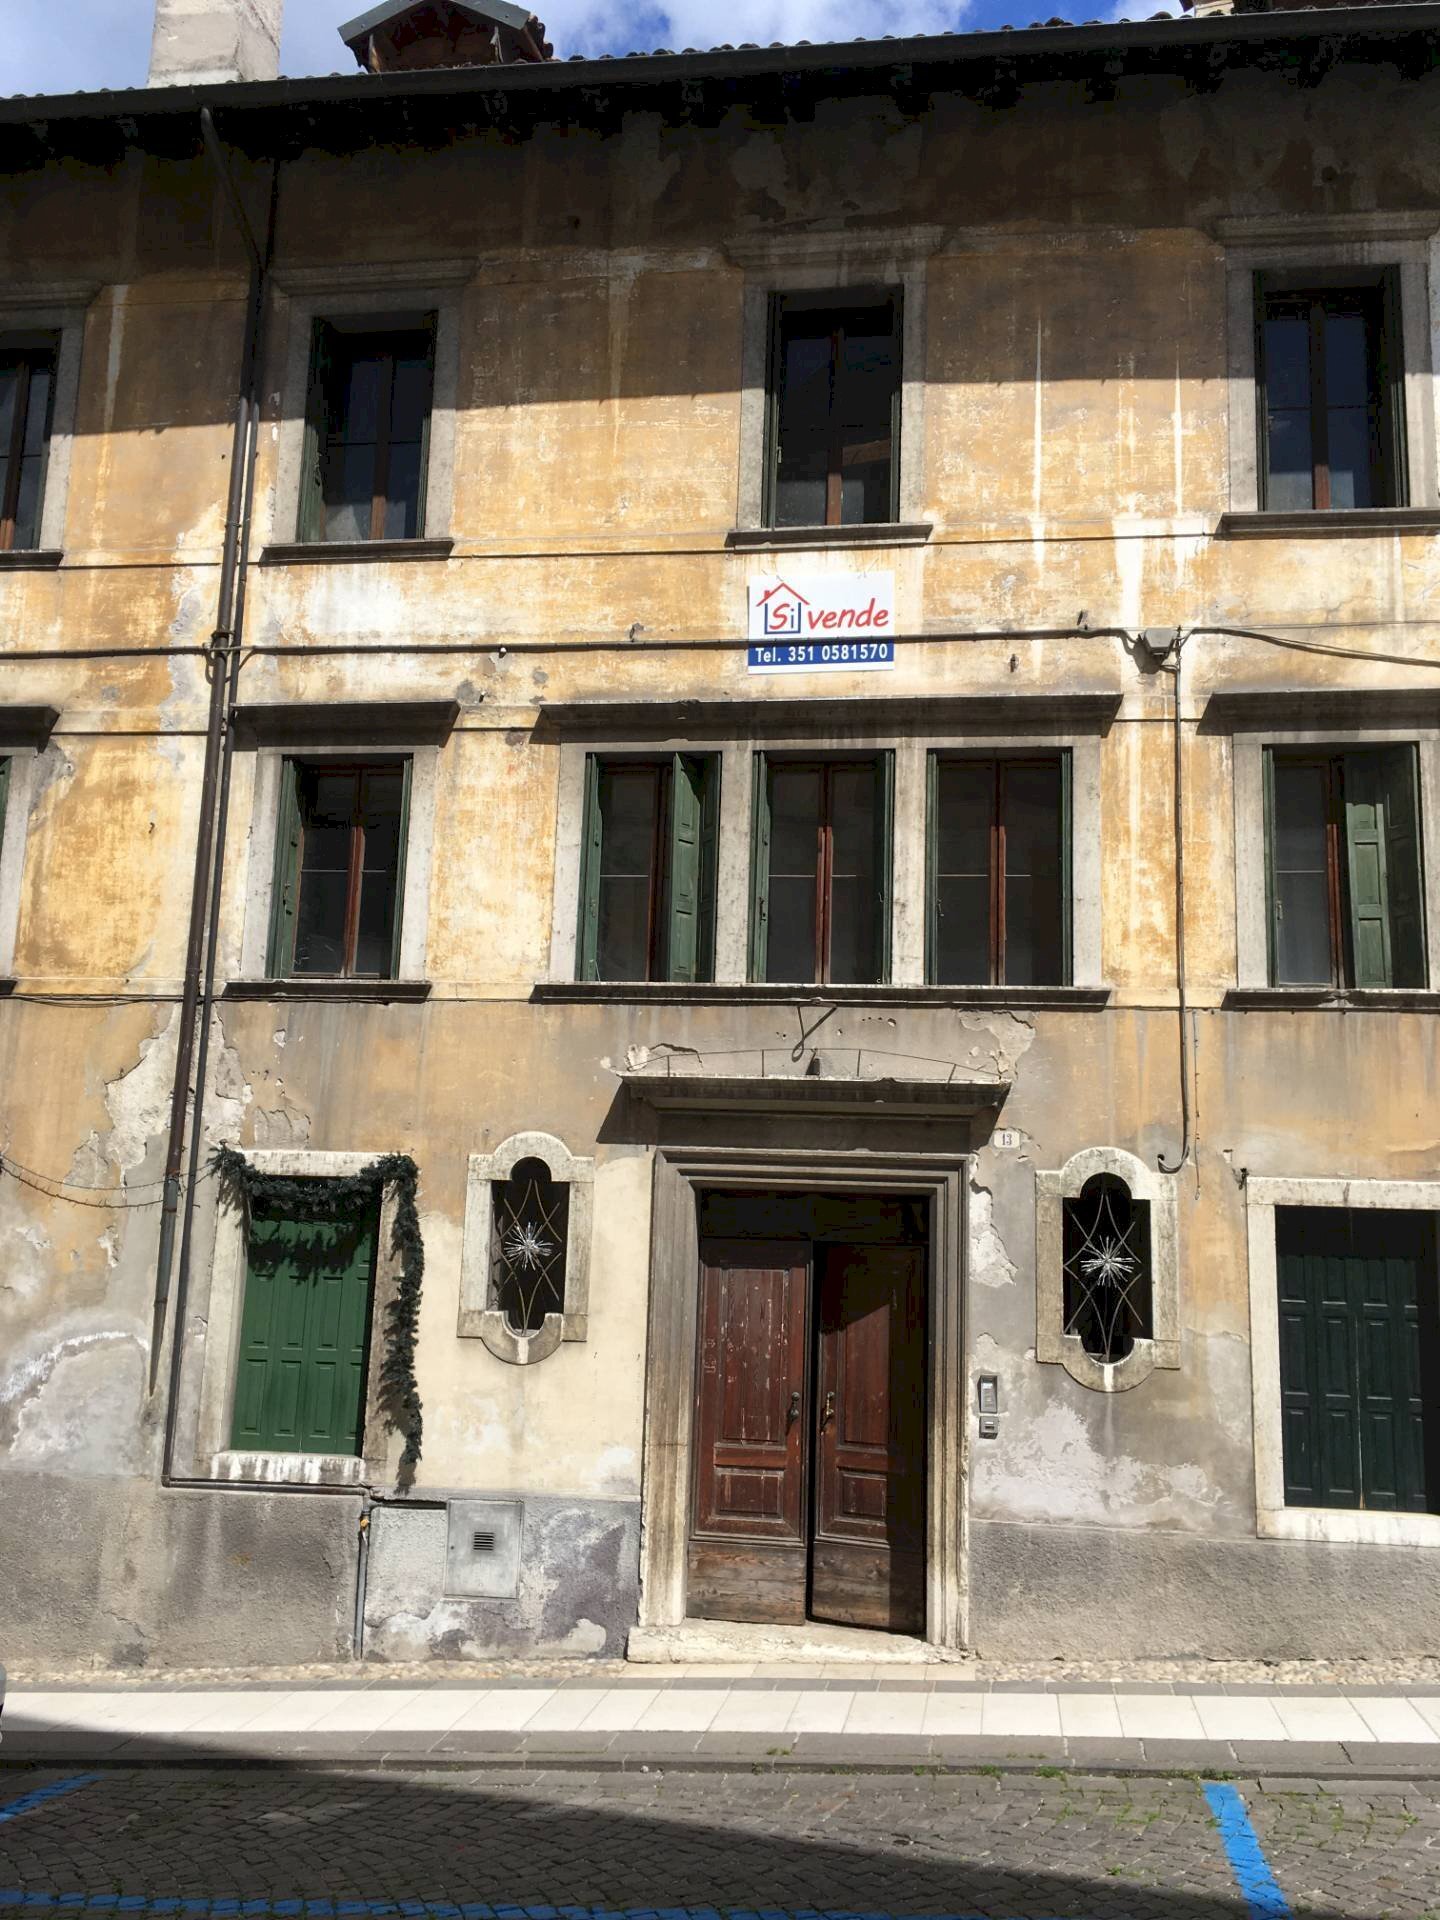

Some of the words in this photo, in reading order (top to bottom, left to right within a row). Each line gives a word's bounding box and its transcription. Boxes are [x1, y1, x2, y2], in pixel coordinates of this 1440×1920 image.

[769, 603, 794, 630] Si
[808, 597, 889, 630] vende
[755, 647, 781, 662] Tel.
[788, 646, 814, 662] 351
[821, 643, 888, 661] 0581570
[1002, 1133, 1012, 1146] 13
